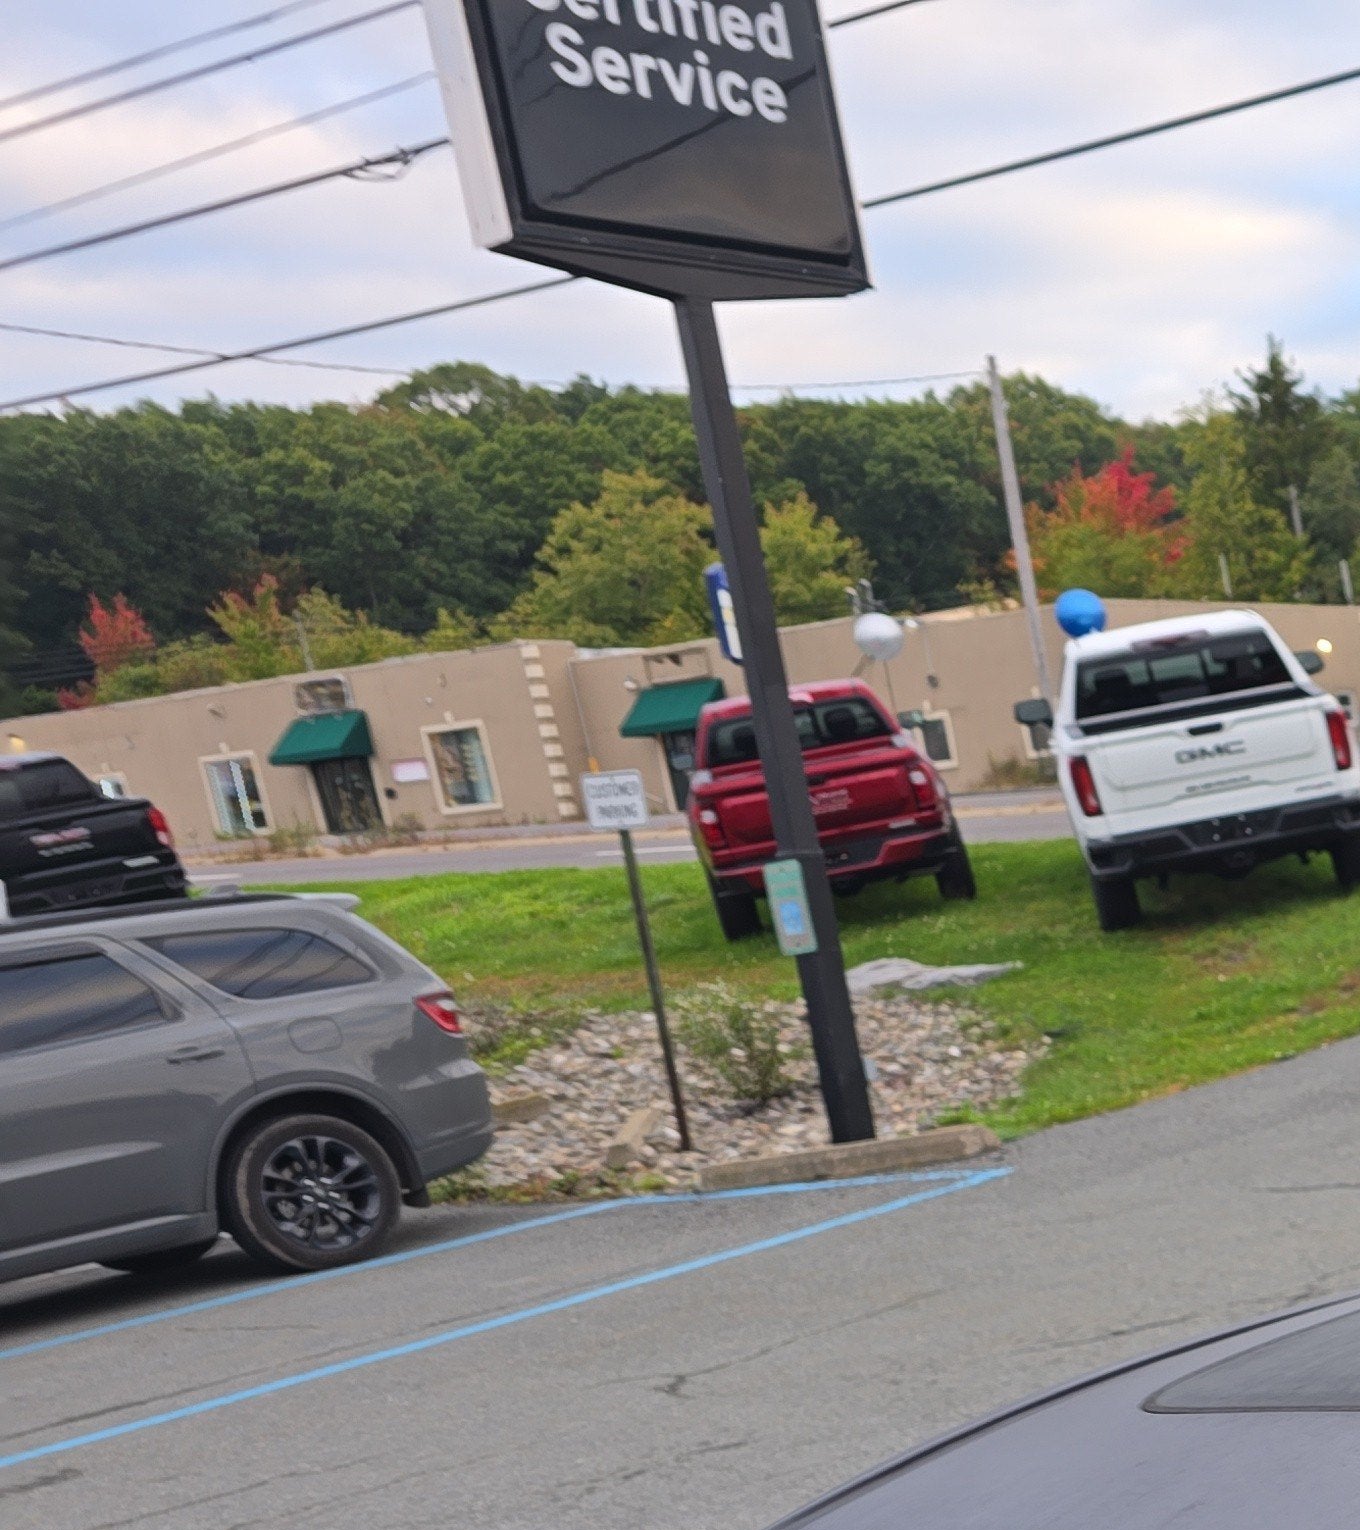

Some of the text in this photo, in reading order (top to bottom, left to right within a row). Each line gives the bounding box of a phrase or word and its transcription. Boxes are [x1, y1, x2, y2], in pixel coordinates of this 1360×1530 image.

[526, 0, 793, 60] ertified
[545, 22, 787, 123] Service
[1175, 740, 1246, 764] GMC
